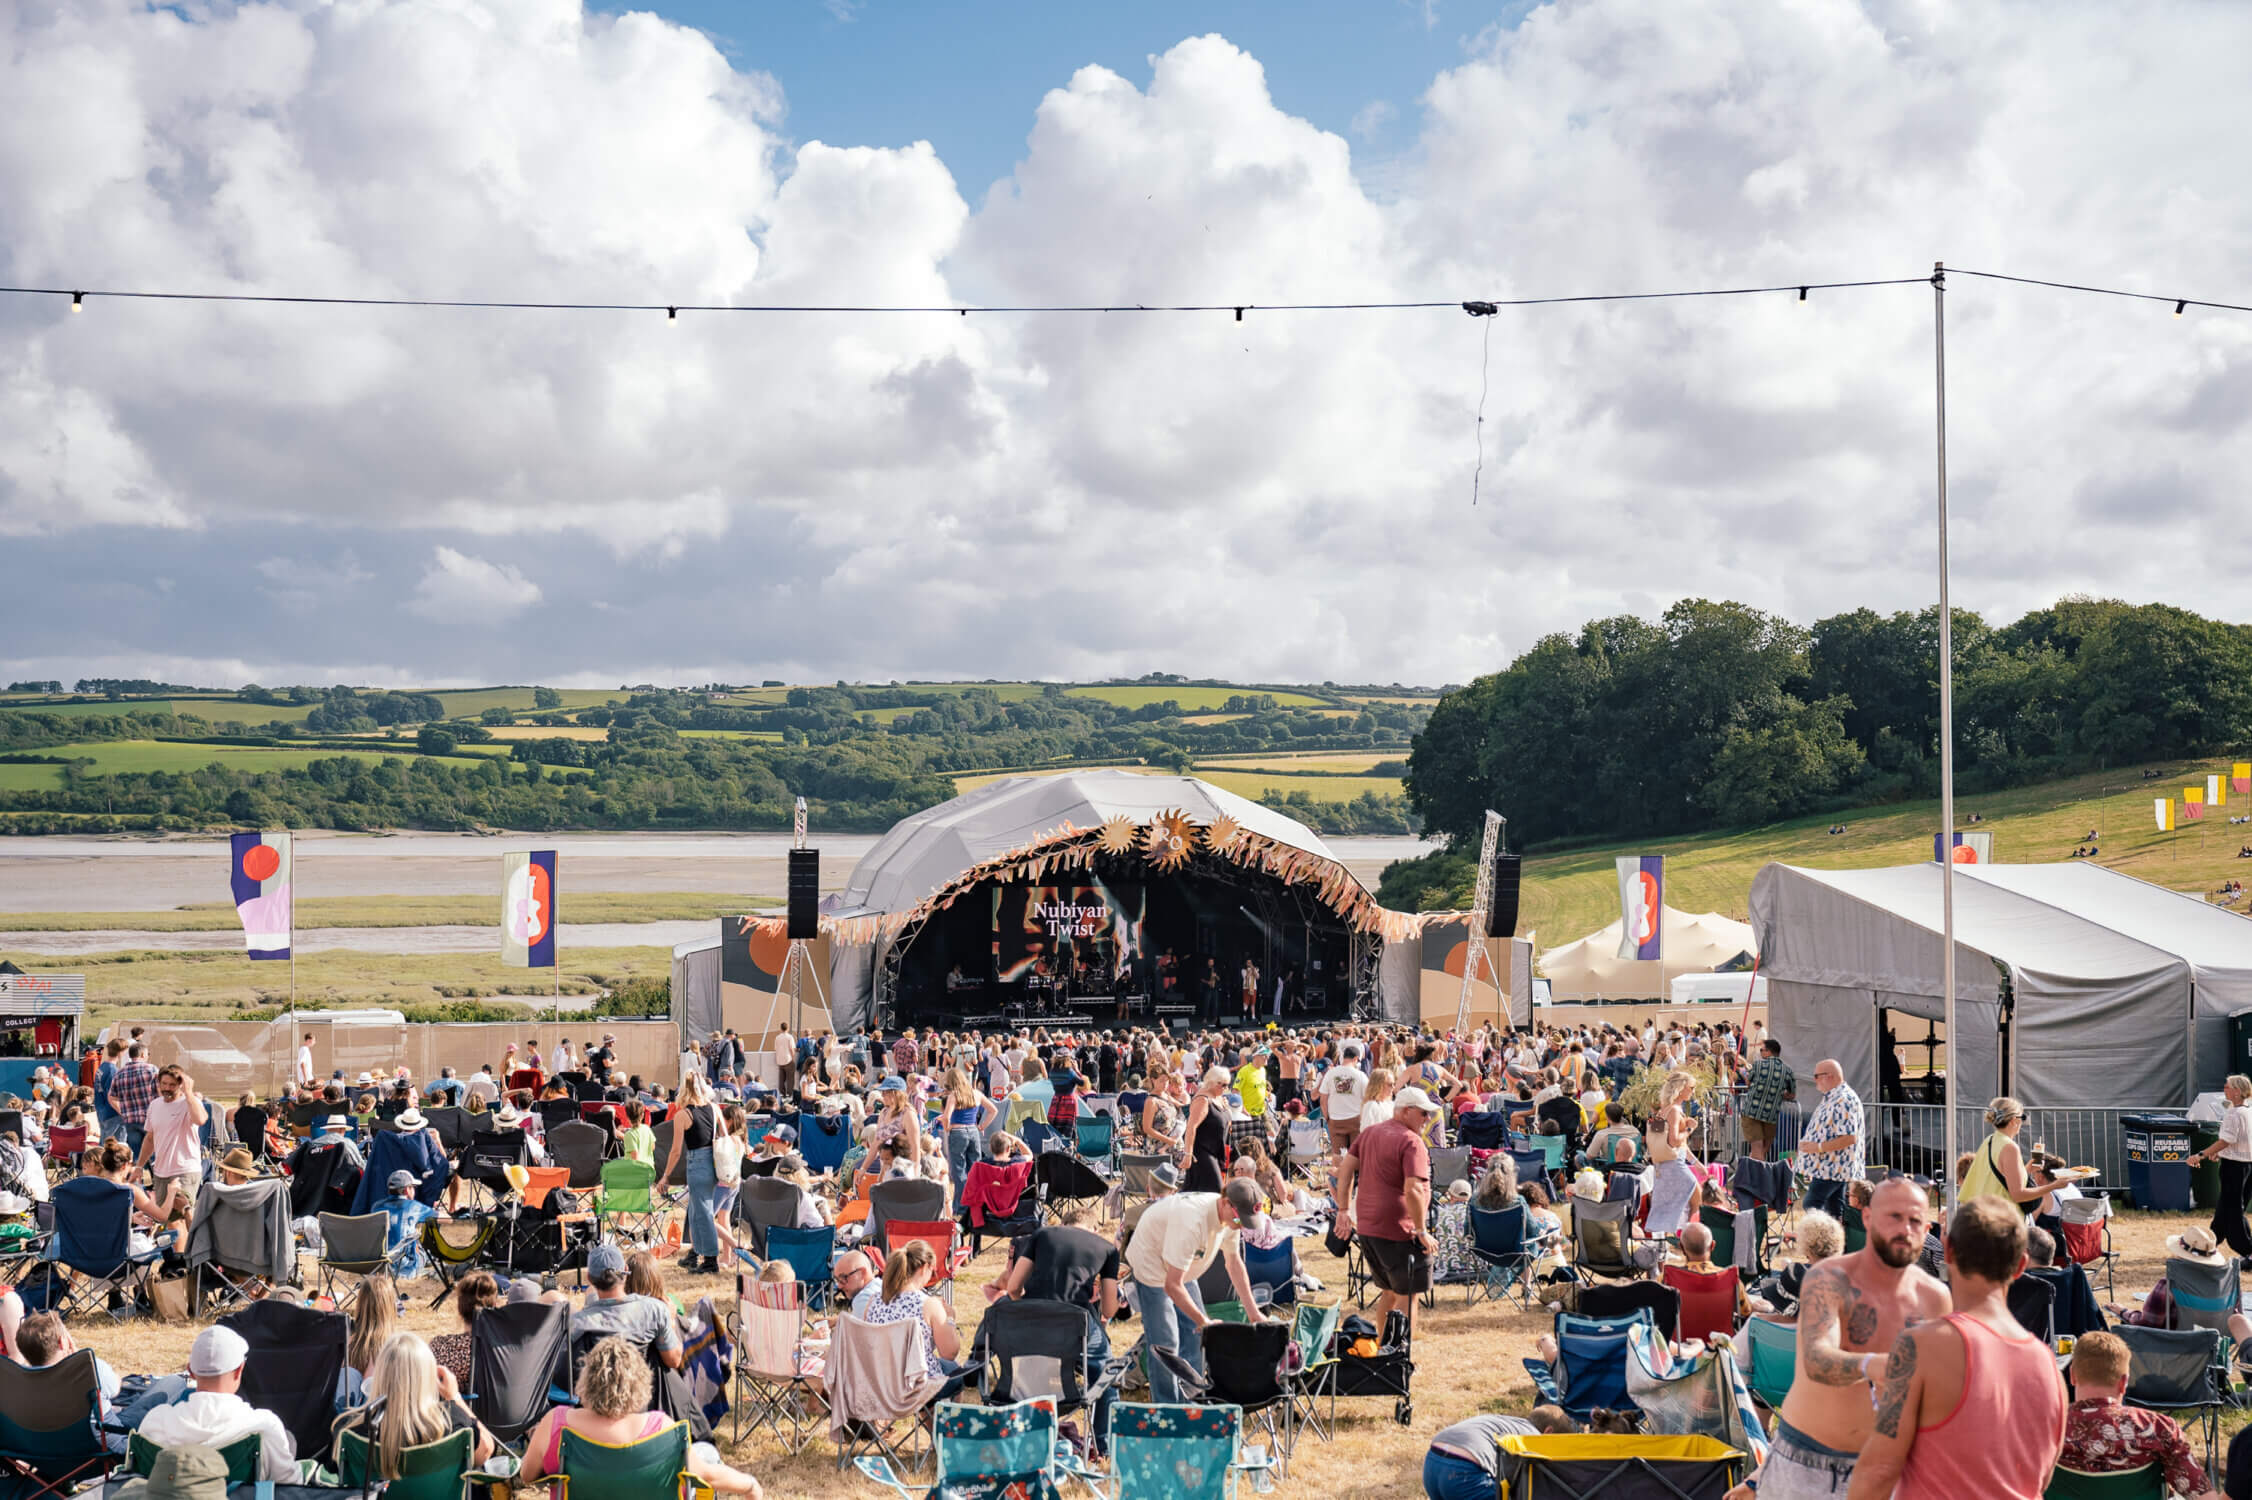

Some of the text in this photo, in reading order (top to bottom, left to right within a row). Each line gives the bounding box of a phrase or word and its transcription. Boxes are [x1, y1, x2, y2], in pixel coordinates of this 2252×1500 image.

[1033, 901, 1107, 923] Nubiyan
[1046, 920, 1095, 936] Twist
[5, 1017, 37, 1026] COLLECT
